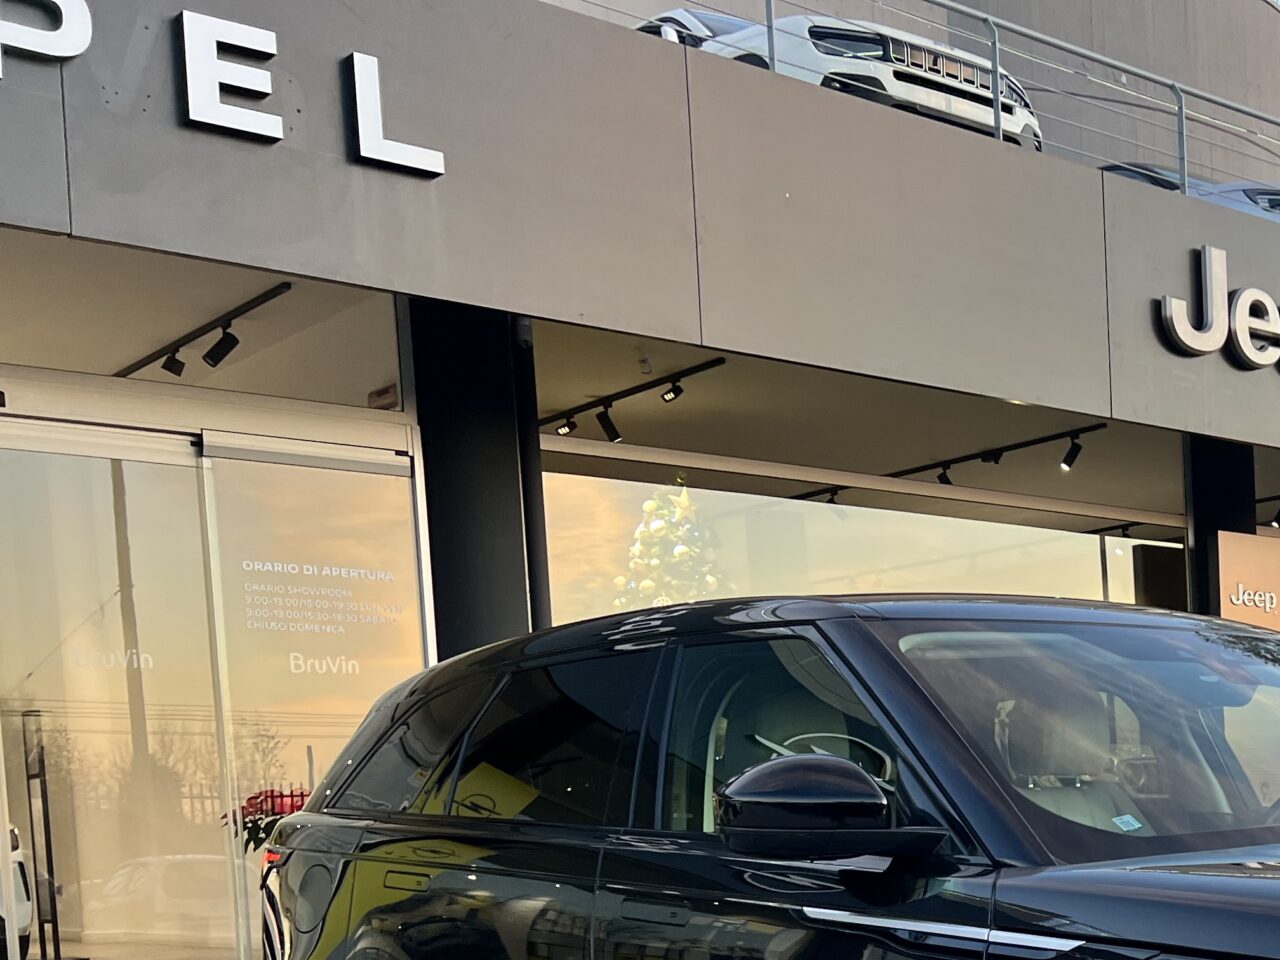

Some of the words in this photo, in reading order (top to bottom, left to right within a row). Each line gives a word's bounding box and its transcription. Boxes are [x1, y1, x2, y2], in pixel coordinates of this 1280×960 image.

[242, 560, 299, 574] ORARIO
[302, 565, 318, 576] DI
[321, 566, 395, 581] APERTURA
[244, 583, 285, 593] ORARIO
[287, 586, 352, 598] SHOWROOM
[1230, 583, 1277, 612] Jeep
[246, 621, 287, 631] CHIUSO
[289, 653, 360, 675] BruVin
